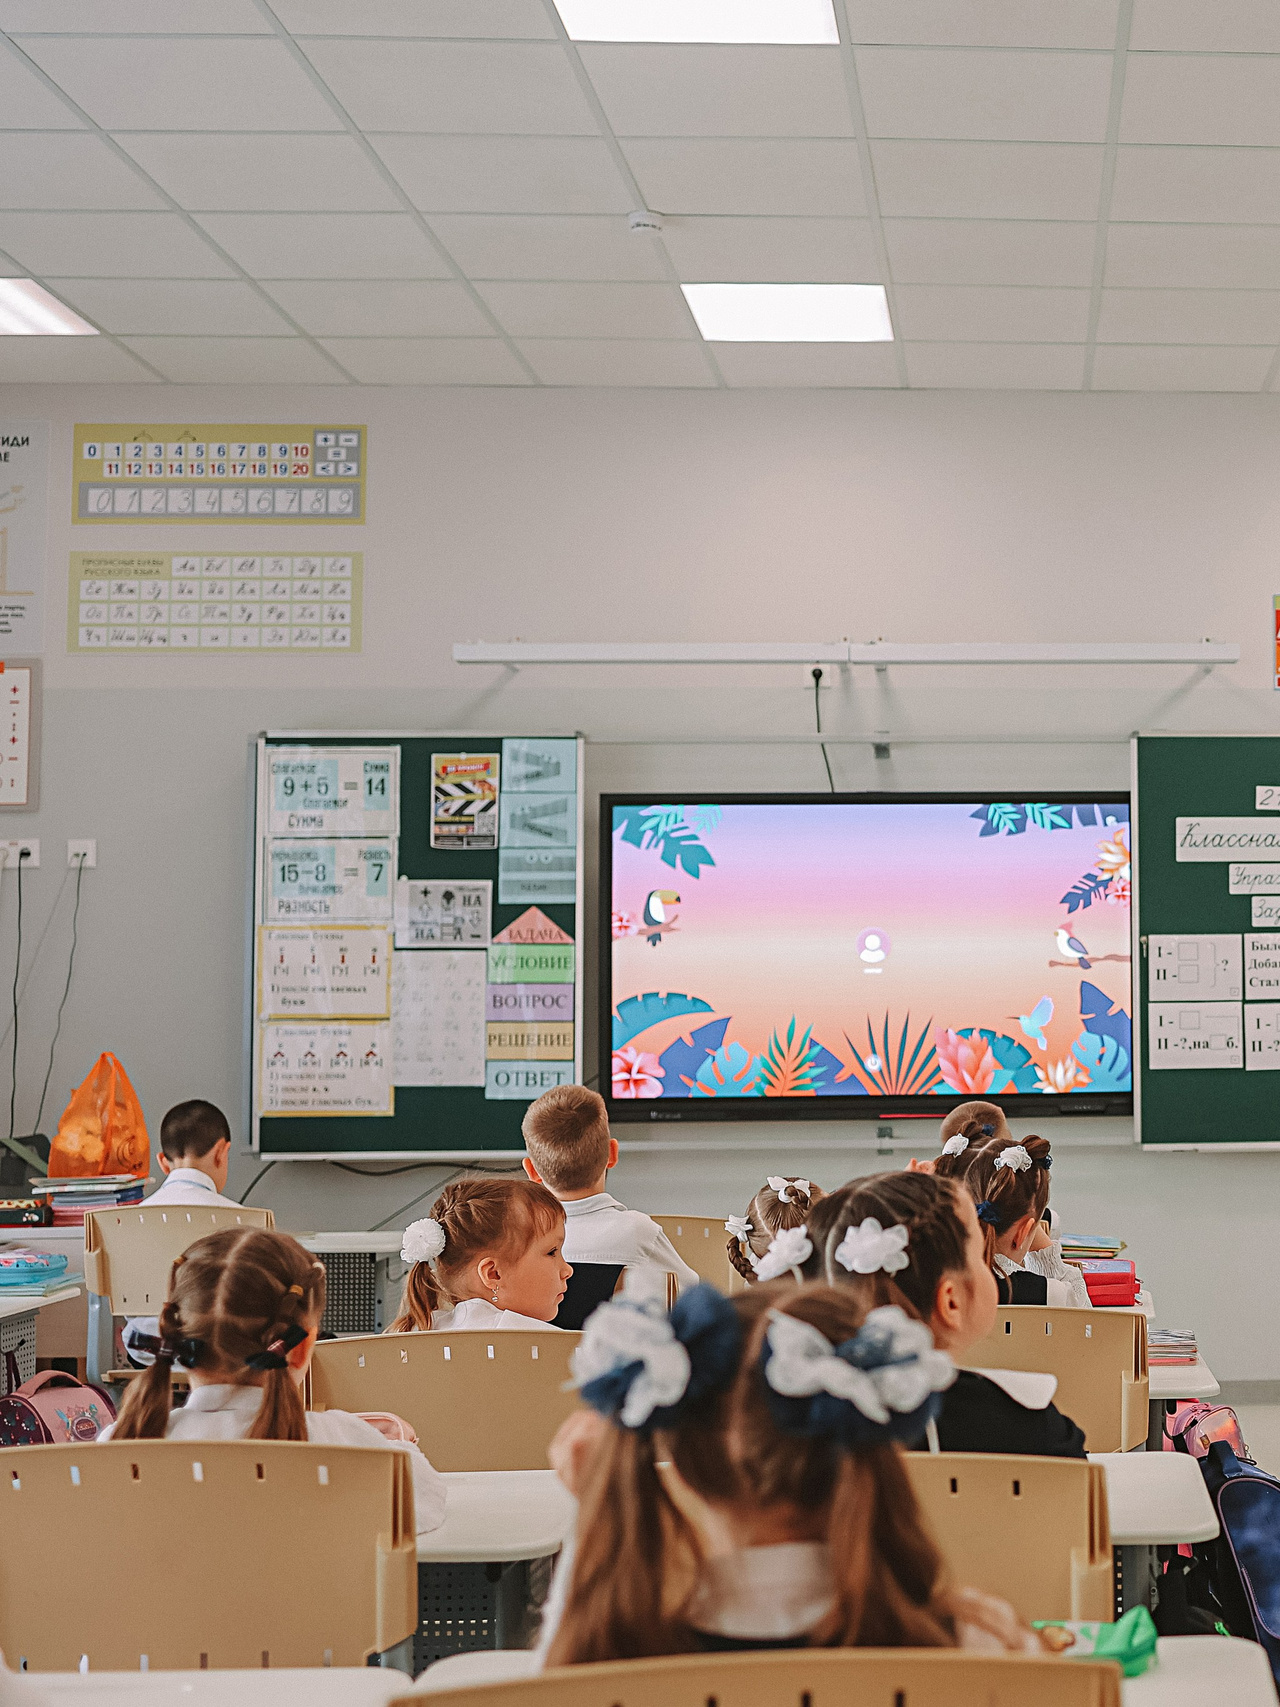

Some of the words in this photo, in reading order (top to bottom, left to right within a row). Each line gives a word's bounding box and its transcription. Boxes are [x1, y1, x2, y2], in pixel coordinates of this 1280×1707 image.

[0, 436, 29, 446] ИДИ
[88, 445, 97, 457] 0
[133, 445, 142, 457] 2
[154, 445, 163, 457] 3
[174, 445, 183, 457] 4
[195, 445, 204, 457] 5
[217, 445, 226, 457] 6
[238, 445, 246, 457] 7
[258, 445, 266, 457] 8
[279, 445, 288, 457] 9
[294, 445, 309, 457] 10
[108, 463, 119, 475] 11
[127, 463, 142, 475] 12
[148, 463, 162, 475] 13
[168, 463, 183, 475] 14
[190, 463, 204, 475] 15
[210, 463, 226, 475] 16
[232, 463, 246, 475] 17
[252, 463, 266, 475] 18
[272, 463, 288, 475] 19
[292, 463, 309, 475] 20
[283, 776, 295, 796] 9
[317, 776, 328, 796] 5
[366, 778, 385, 796] 14
[280, 864, 298, 882] 15
[315, 864, 326, 882] 8
[372, 864, 384, 882] 7
[491, 956, 572, 970] УСЛОВИЕ
[492, 994, 566, 1010] ВОПРОС
[488, 1033, 572, 1047] РЕШЕНИЕ
[495, 1070, 566, 1087] ОТВЕТ
